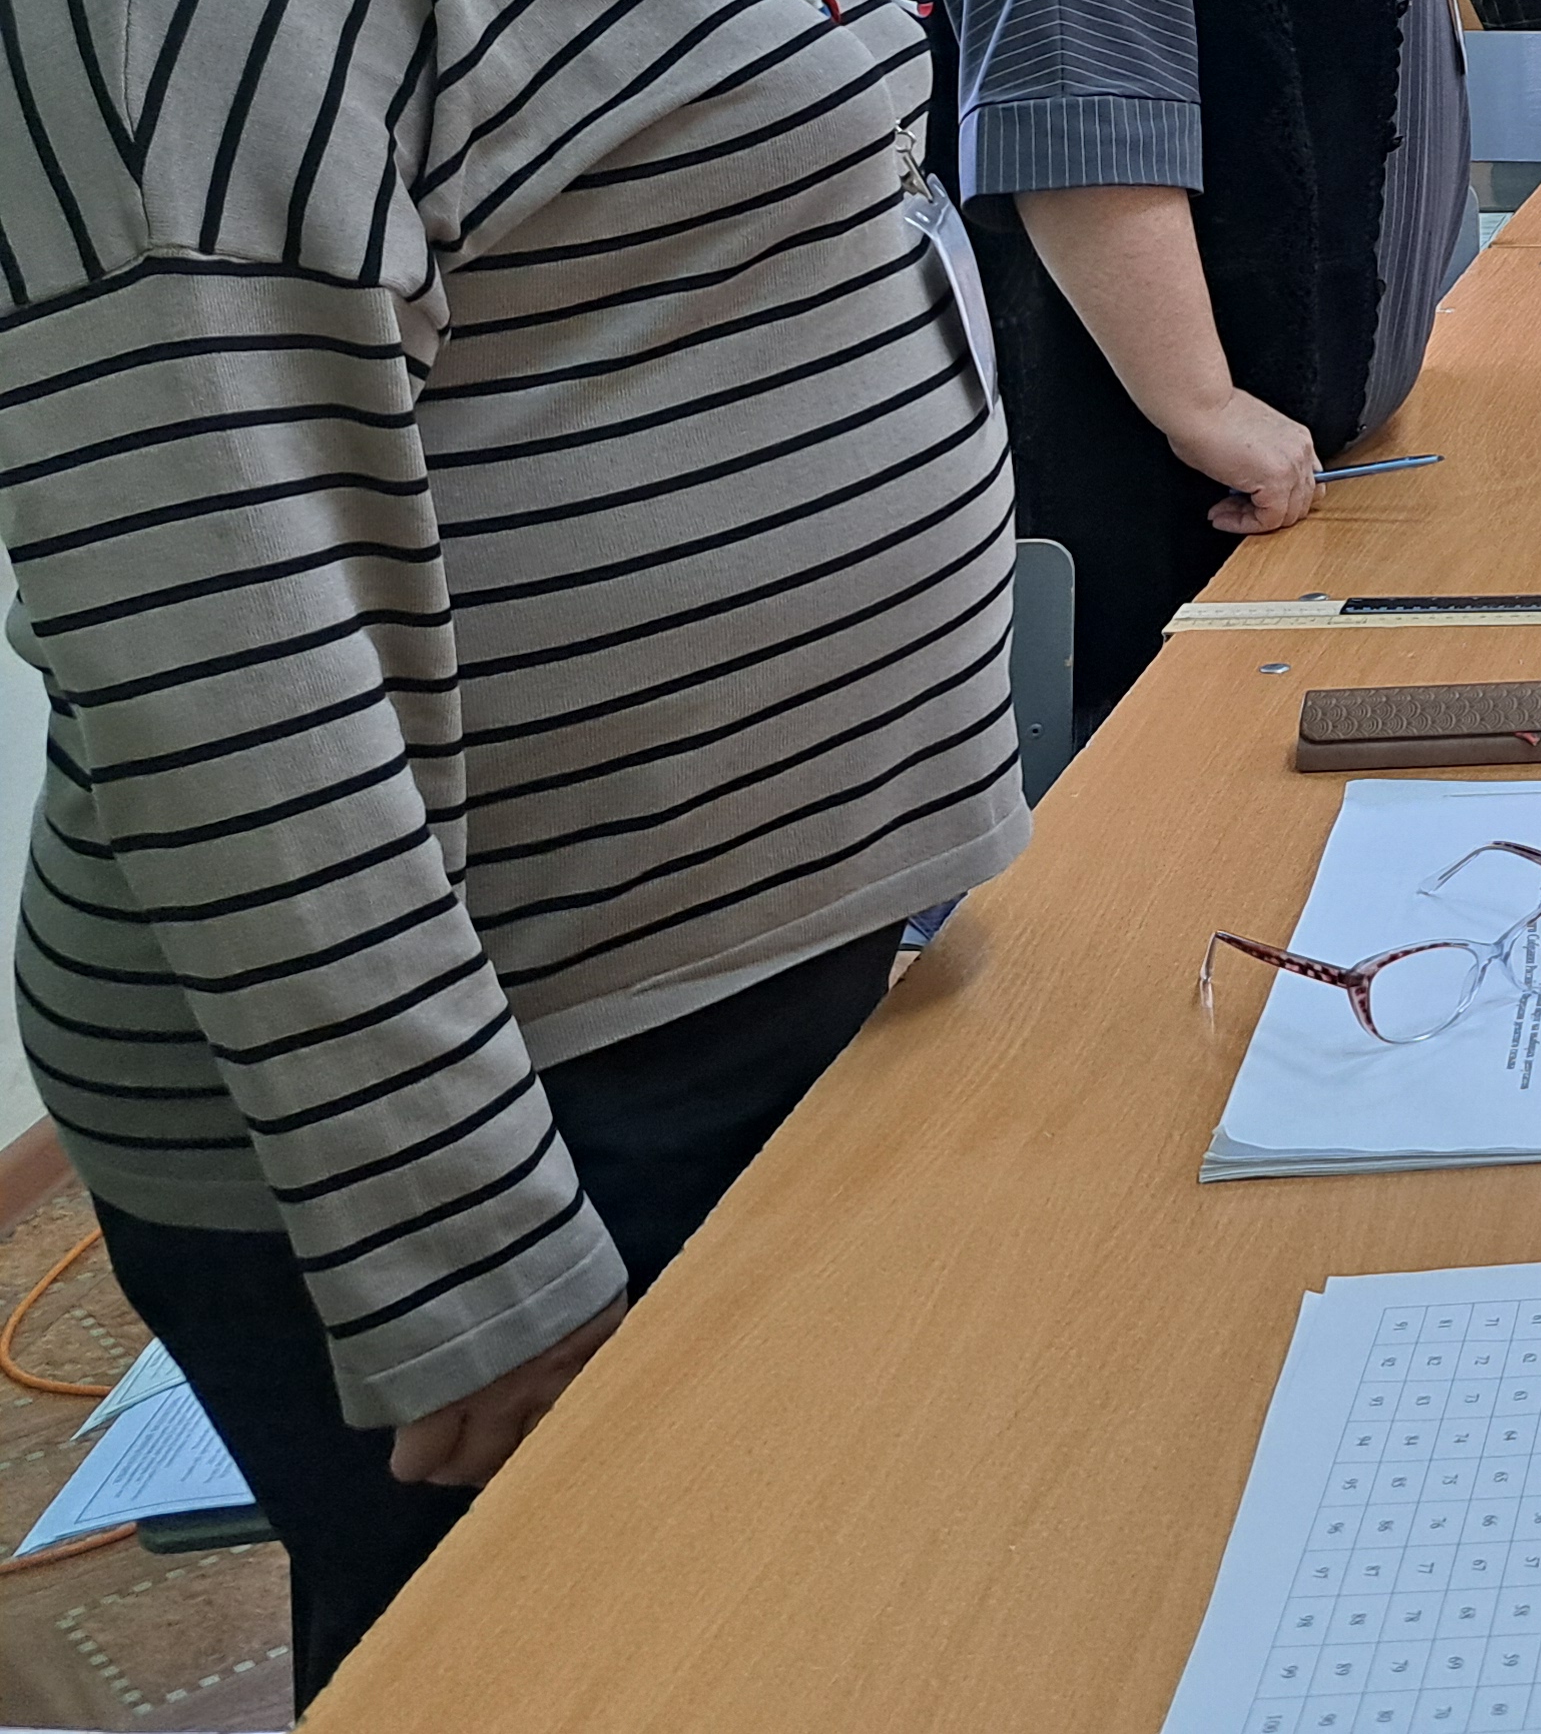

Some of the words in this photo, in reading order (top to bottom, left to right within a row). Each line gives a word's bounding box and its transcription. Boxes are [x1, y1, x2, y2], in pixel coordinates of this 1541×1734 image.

[1393, 1321, 1409, 1331] 91
[1437, 1319, 1453, 1329] 81
[1484, 1317, 1500, 1327] 71
[1380, 1356, 1397, 1368] 92
[1426, 1355, 1443, 1366] 82
[1474, 1355, 1491, 1366] 72
[1522, 1352, 1537, 1364] 62
[1368, 1396, 1384, 1407] 93
[1415, 1395, 1432, 1407] 83
[1464, 1393, 1480, 1404] 73
[1513, 1390, 1528, 1402] 63
[1356, 1435, 1372, 1447] 94
[1403, 1435, 1420, 1447] 84
[1453, 1433, 1470, 1444] 74
[1503, 1430, 1518, 1442] 64
[1442, 1474, 1459, 1486] 75
[1493, 1471, 1509, 1483] 65
[1342, 1478, 1359, 1491] 95
[1429, 1517, 1447, 1530] 76
[1481, 1514, 1498, 1527] 66
[1417, 1562, 1435, 1574] 77
[1472, 1559, 1488, 1572] 67
[1525, 1556, 1541, 1569] 57
[1313, 1566, 1330, 1579] 97
[1364, 1565, 1381, 1577] 87
[1404, 1609, 1422, 1623] 78
[1459, 1606, 1476, 1620] 68
[1513, 1604, 1531, 1617] 58
[1391, 1659, 1409, 1673] 79
[1447, 1656, 1464, 1670] 69
[1502, 1653, 1521, 1667] 59
[1280, 1665, 1299, 1679] 99
[1334, 1662, 1353, 1677] 89
[1433, 1706, 1453, 1720] 70
[1492, 1703, 1508, 1716] 60
[1318, 1713, 1337, 1727] 90
[1376, 1710, 1394, 1723] 80
